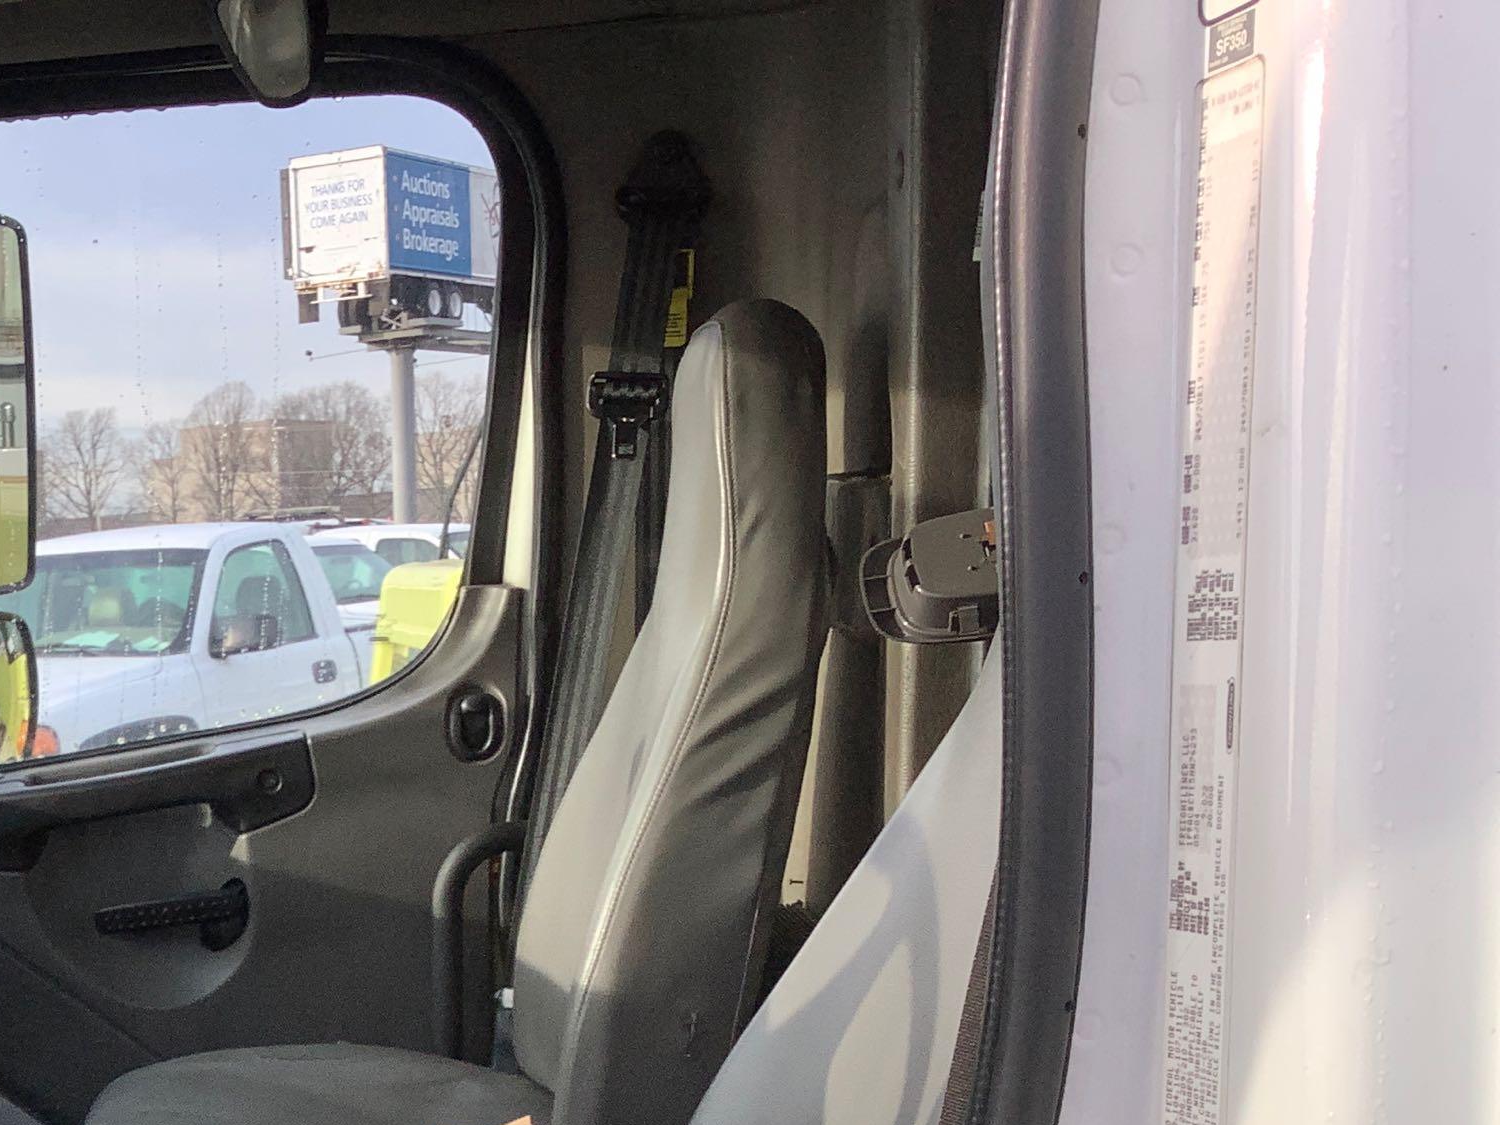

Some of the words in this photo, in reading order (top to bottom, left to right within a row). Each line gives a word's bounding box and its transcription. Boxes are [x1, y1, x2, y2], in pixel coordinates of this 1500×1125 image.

[1216, 29, 1248, 57] SF350
[311, 182, 345, 195] THANKS
[347, 178, 365, 192] FOR
[401, 170, 450, 200] Auctions
[305, 200, 331, 213] YOUR
[332, 193, 373, 210] BUSINESS
[403, 199, 459, 228] Appraisals
[310, 215, 337, 229] COME
[338, 210, 368, 226] AGAIN
[403, 228, 459, 261] Brokerage
[1181, 735, 1189, 755] LLC
[1178, 762, 1188, 845] FREIGHTLINER
[1211, 894, 1219, 964] INCOMPLETE
[1218, 943, 1223, 958] TO
[1191, 973, 1197, 989] TO
[1209, 998, 1214, 1013] IN
[1165, 1065, 1173, 1113] FEDERAL
[1169, 969, 1177, 1018] VEHICLE
[1187, 995, 1196, 1064] APPLICABLE
[1194, 989, 1202, 1079] SUBSTANTIALLY
[1205, 1019, 1214, 1103] INSTRUCTIONS
